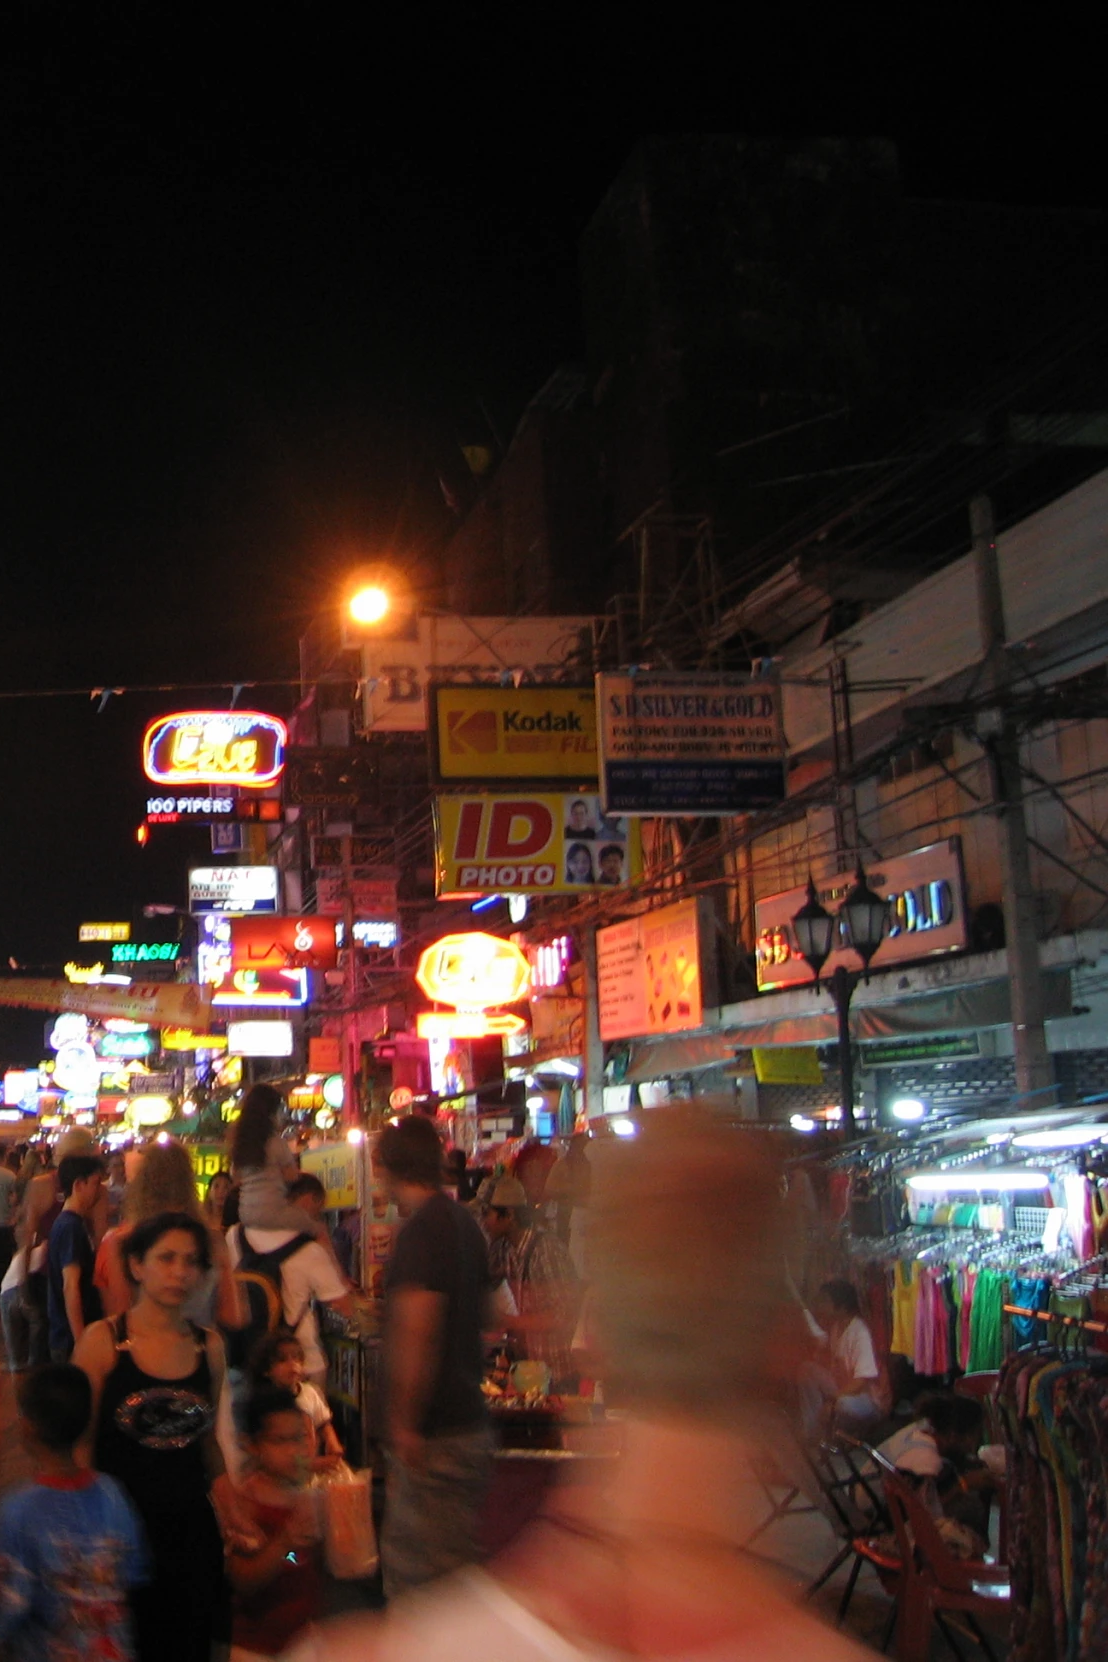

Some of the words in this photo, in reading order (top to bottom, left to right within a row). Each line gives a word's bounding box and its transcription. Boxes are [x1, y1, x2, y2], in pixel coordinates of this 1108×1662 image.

[503, 711, 583, 732] Kodak
[612, 725, 668, 737] FACTORY
[673, 725, 696, 737] FOR
[729, 725, 772, 737] SILVER
[147, 797, 175, 813] 100
[177, 797, 234, 813] PIPERS
[455, 802, 553, 860] ID
[460, 865, 554, 887] PHOTO
